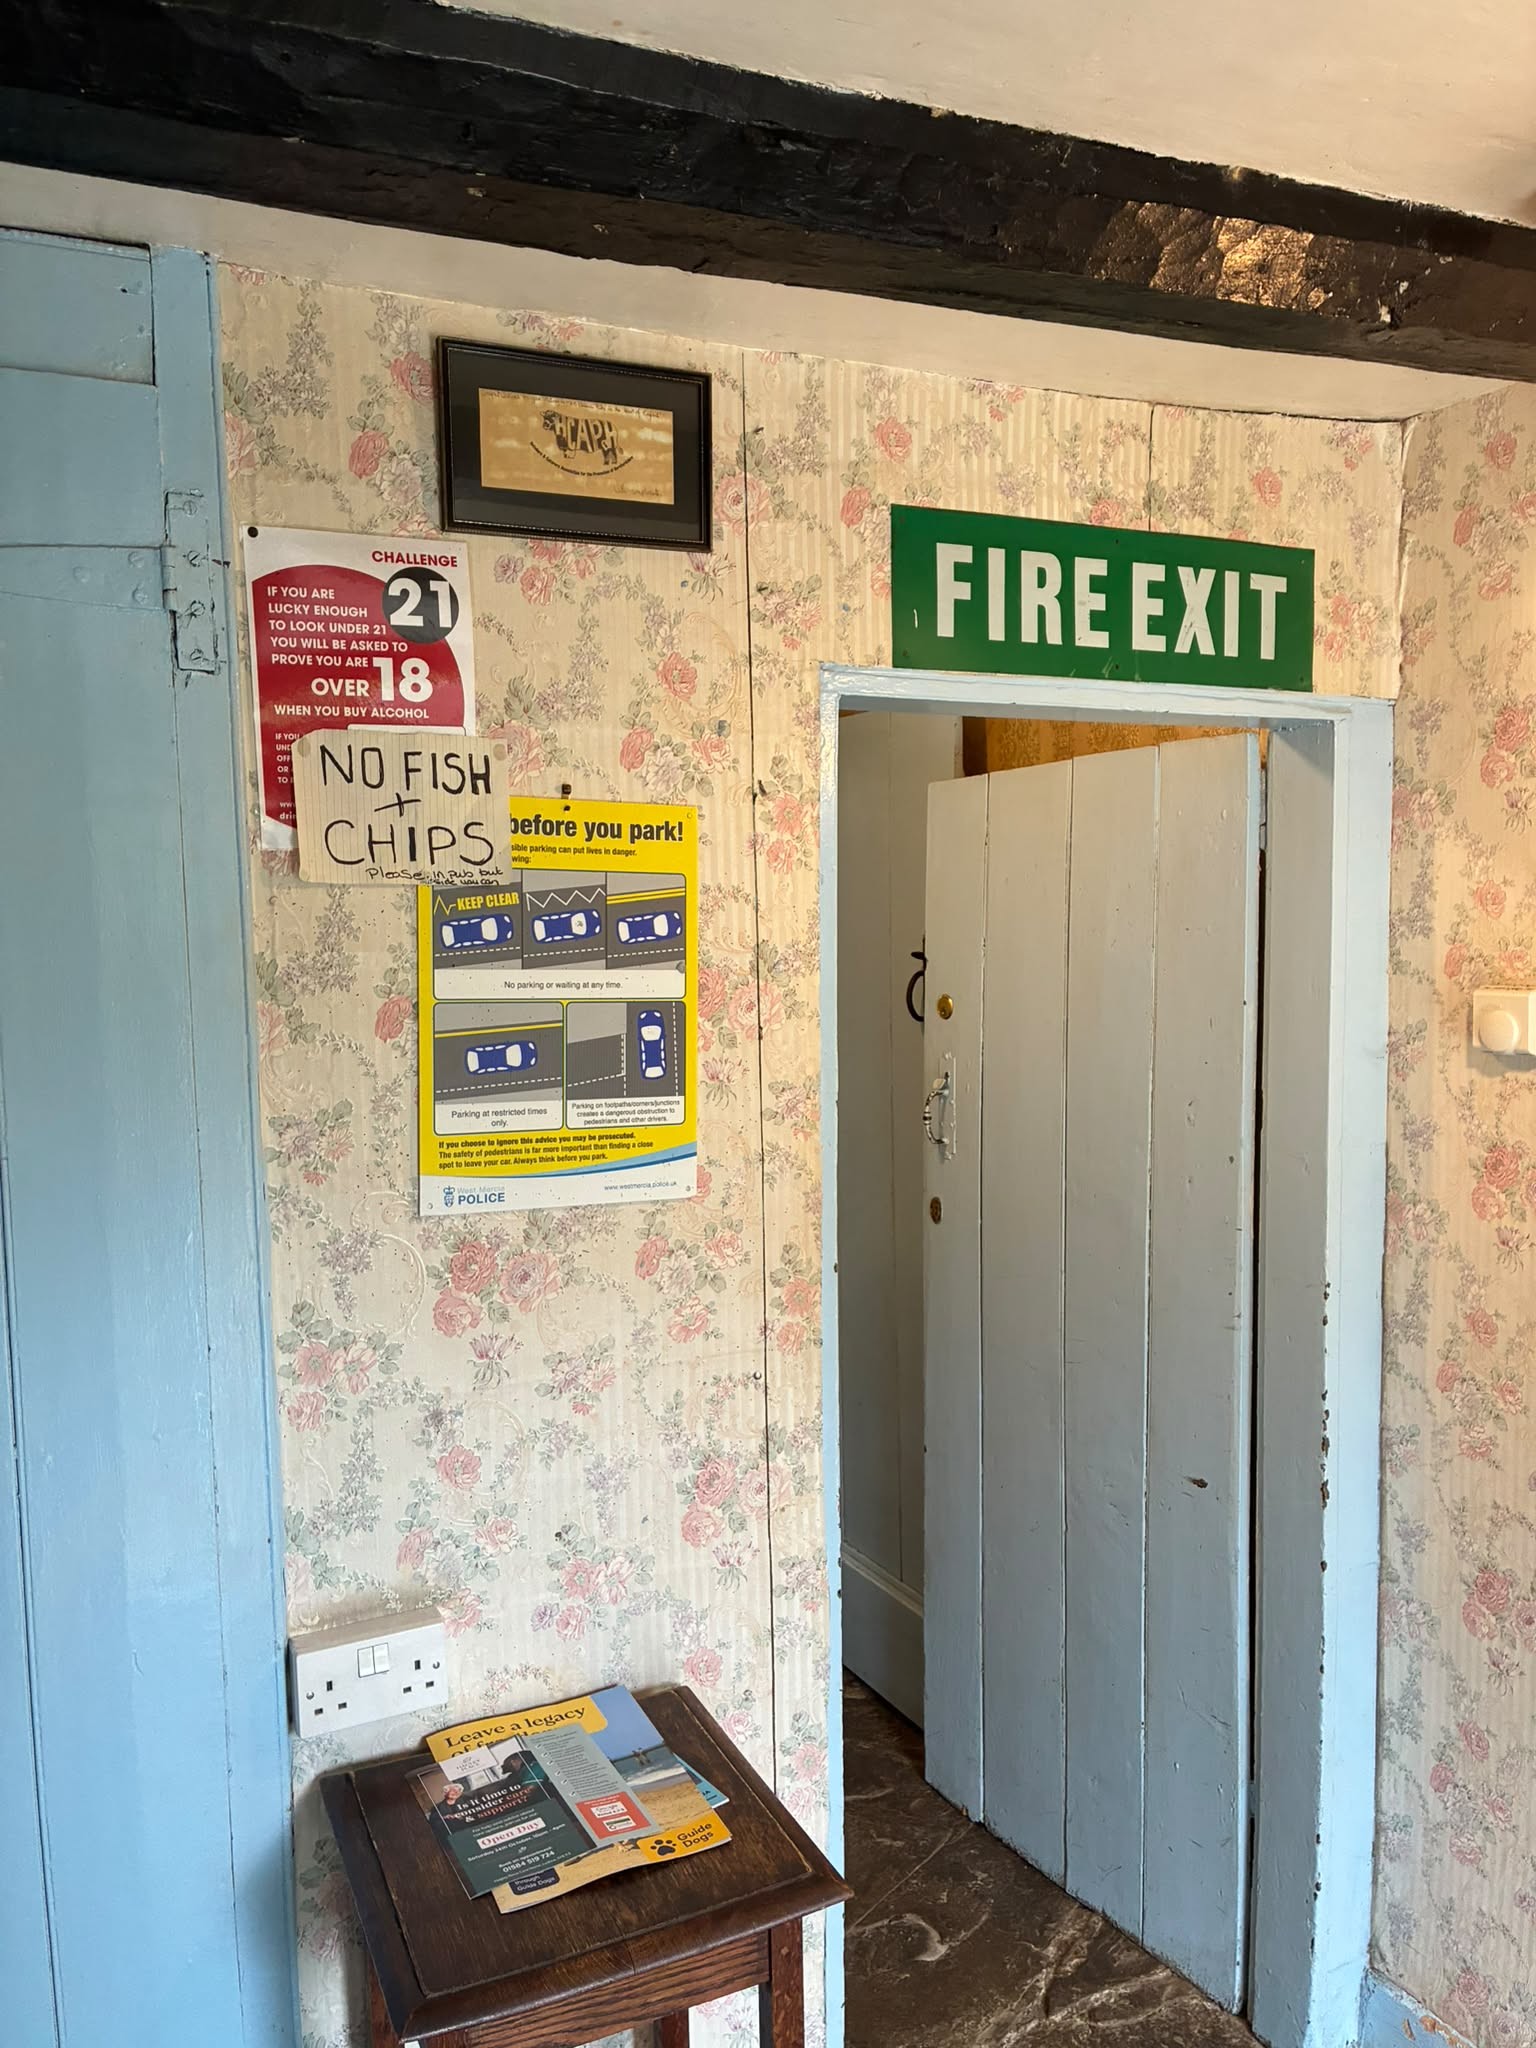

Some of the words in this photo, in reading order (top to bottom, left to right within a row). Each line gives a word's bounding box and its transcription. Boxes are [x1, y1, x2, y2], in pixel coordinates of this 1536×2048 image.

[372, 550, 457, 567] CHALLENGE
[267, 586, 278, 597] IF
[281, 587, 308, 598] YOU
[311, 588, 335, 600] ARE
[936, 542, 1109, 648] FIRE
[1131, 561, 1287, 660] EXIT
[268, 603, 310, 615] LUCKY
[314, 605, 368, 617] ENOUGH
[387, 577, 452, 628] 21
[269, 620, 286, 631] TO
[290, 621, 325, 633] LOOK
[329, 623, 370, 635] UNDER
[373, 624, 387, 635] 21
[271, 637, 297, 648] YOU
[300, 638, 328, 649] WILL
[332, 639, 346, 650] BE
[350, 640, 389, 651] ASKED
[392, 641, 408, 652] TO
[271, 654, 313, 665] PROVE
[315, 656, 341, 667] YOU
[345, 656, 368, 668] ARE
[311, 678, 370, 697] OVER
[373, 657, 433, 702] 18
[274, 704, 311, 716] WHEN
[314, 706, 340, 717] YOU
[344, 706, 367, 718] BUY
[371, 707, 429, 719] ALCOHOL
[319, 744, 384, 789] NO
[404, 751, 492, 794] FISH
[510, 813, 577, 837] before
[584, 821, 622, 842] you
[629, 821, 684, 844] park!
[324, 819, 494, 866] CHIPS
[529, 845, 557, 854] parking
[573, 847, 585, 855] put
[604, 847, 611, 855] in
[612, 848, 637, 857] danger.
[448, 869, 473, 879] pub
[479, 866, 503, 876] but
[481, 878, 499, 886] can
[457, 897, 484, 911] KEEP
[485, 892, 519, 908] CLEAR
[517, 980, 544, 990] parking
[555, 981, 581, 990] waiting
[591, 982, 604, 990] any
[451, 1110, 480, 1119] Parking
[491, 1108, 526, 1117] restricted
[528, 1107, 547, 1115] times
[571, 1102, 594, 1110] Parking
[491, 1119, 508, 1128] only.
[584, 1118, 617, 1126] pedestrians
[445, 1142, 459, 1150] you
[461, 1140, 486, 1148] choose
[496, 1138, 519, 1147] ignore
[535, 1135, 557, 1143] advice
[598, 1132, 636, 1141] prosecuted.
[439, 1151, 451, 1159] The
[453, 1150, 474, 1158] safety
[475, 1149, 482, 1157] of
[484, 1147, 522, 1157] pedestrians
[561, 1143, 592, 1152] important
[593, 1142, 608, 1150] than
[609, 1141, 631, 1150] finding
[439, 1161, 454, 1170] spot
[483, 1159, 498, 1168] your
[513, 1157, 537, 1165] Always
[579, 1154, 590, 1162] you
[458, 1192, 505, 1205] POLICE
[444, 1724, 506, 1748] Leave
[511, 1721, 522, 1731] a
[524, 1707, 585, 1728] legacy
[481, 1790, 508, 1804] time
[509, 1784, 521, 1792] to
[454, 1798, 504, 1819] consider
[477, 1796, 528, 1818] support?
[481, 1830, 514, 1848] Open
[516, 1822, 540, 1836] Day
[677, 1824, 712, 1841] Guide
[682, 1833, 714, 1848] Dogs
[502, 1861, 526, 1873] 01584
[527, 1855, 540, 1865] 519
[541, 1850, 555, 1860] 724
[517, 1882, 537, 1892] Guide
